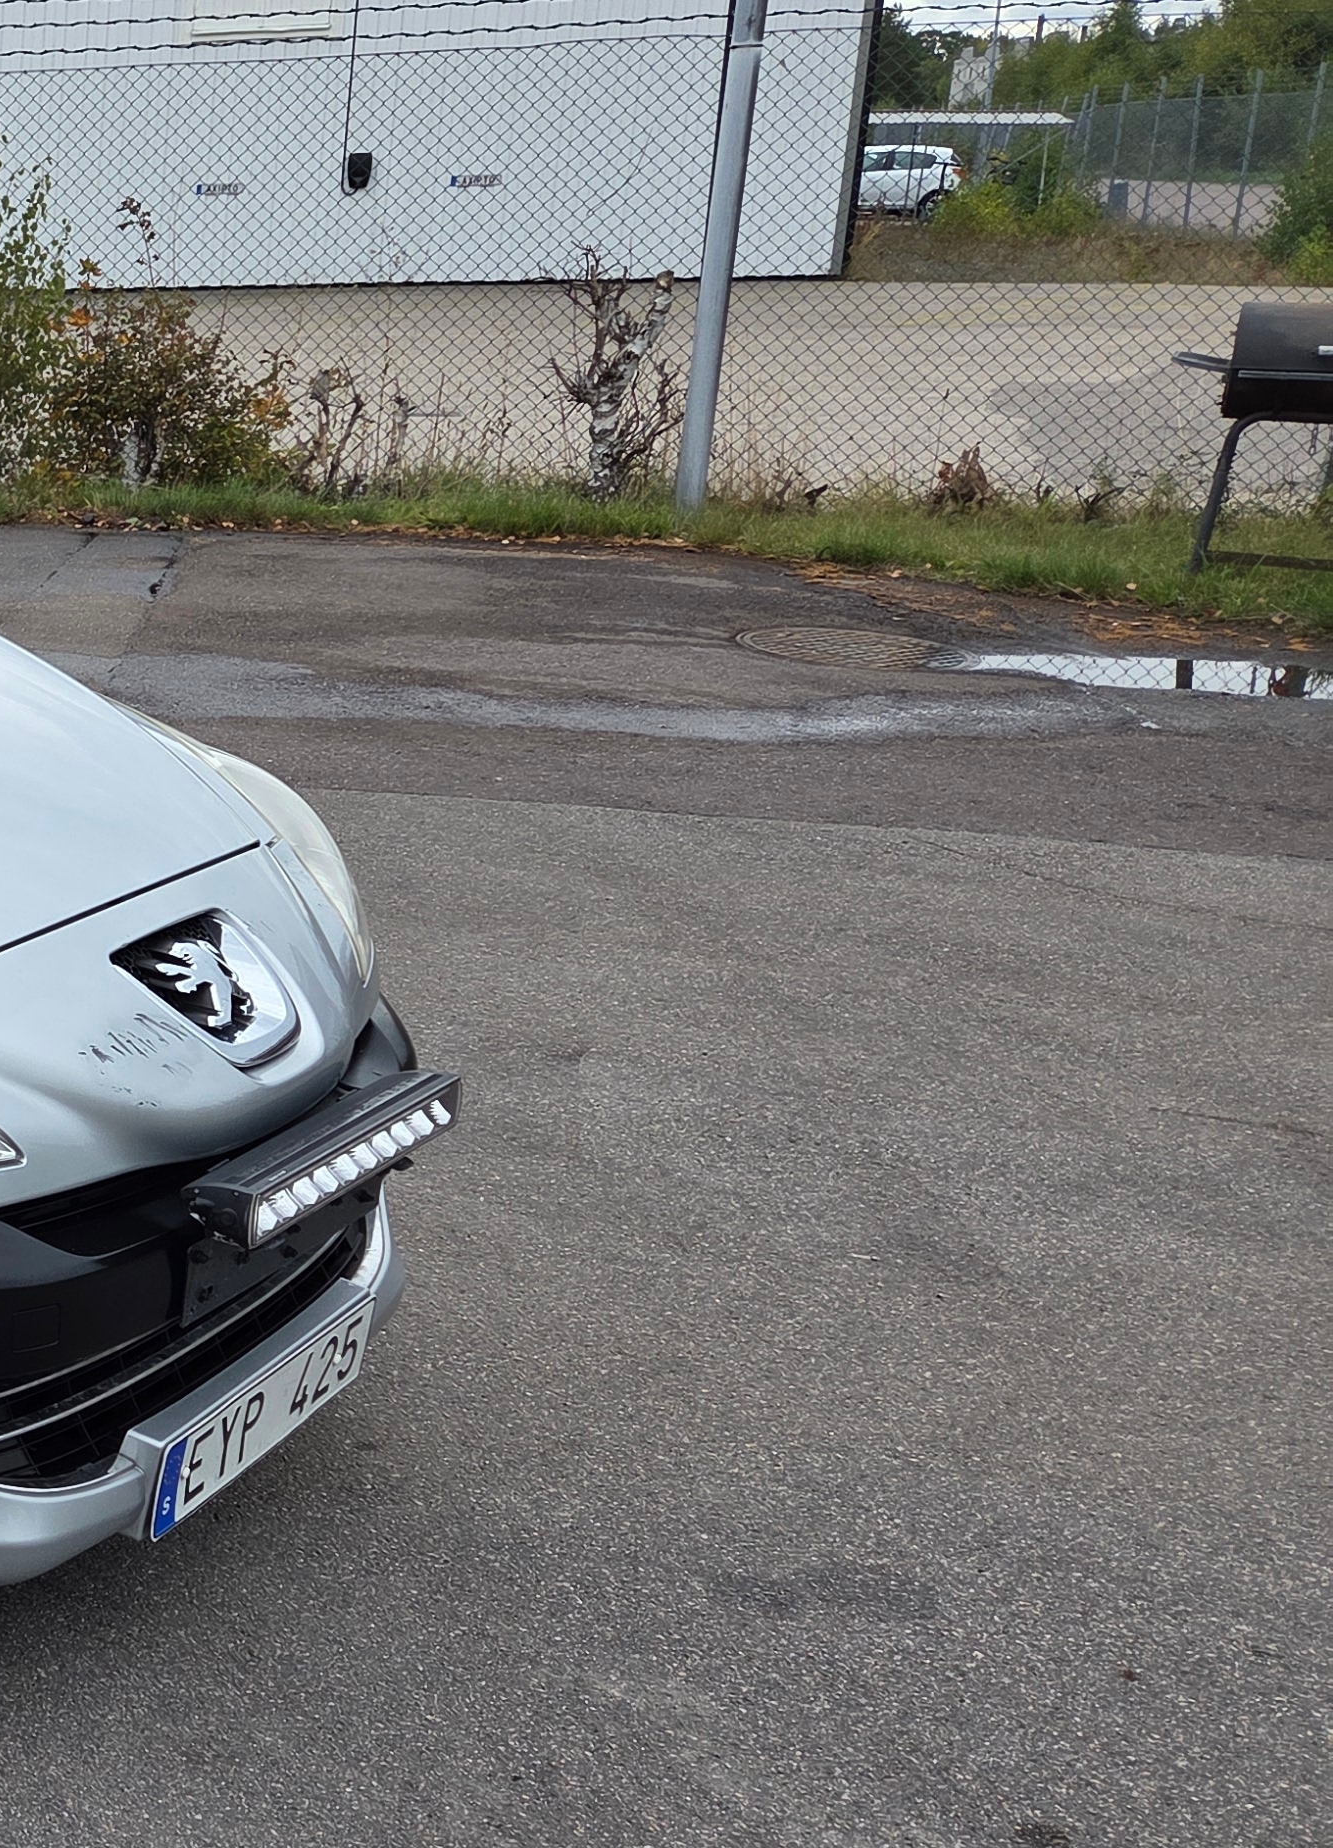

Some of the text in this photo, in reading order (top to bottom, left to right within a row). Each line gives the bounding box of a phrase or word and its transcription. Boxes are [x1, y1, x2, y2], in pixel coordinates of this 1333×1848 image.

[183, 1315, 364, 1505] EYP 425
[161, 1496, 171, 1516] S
